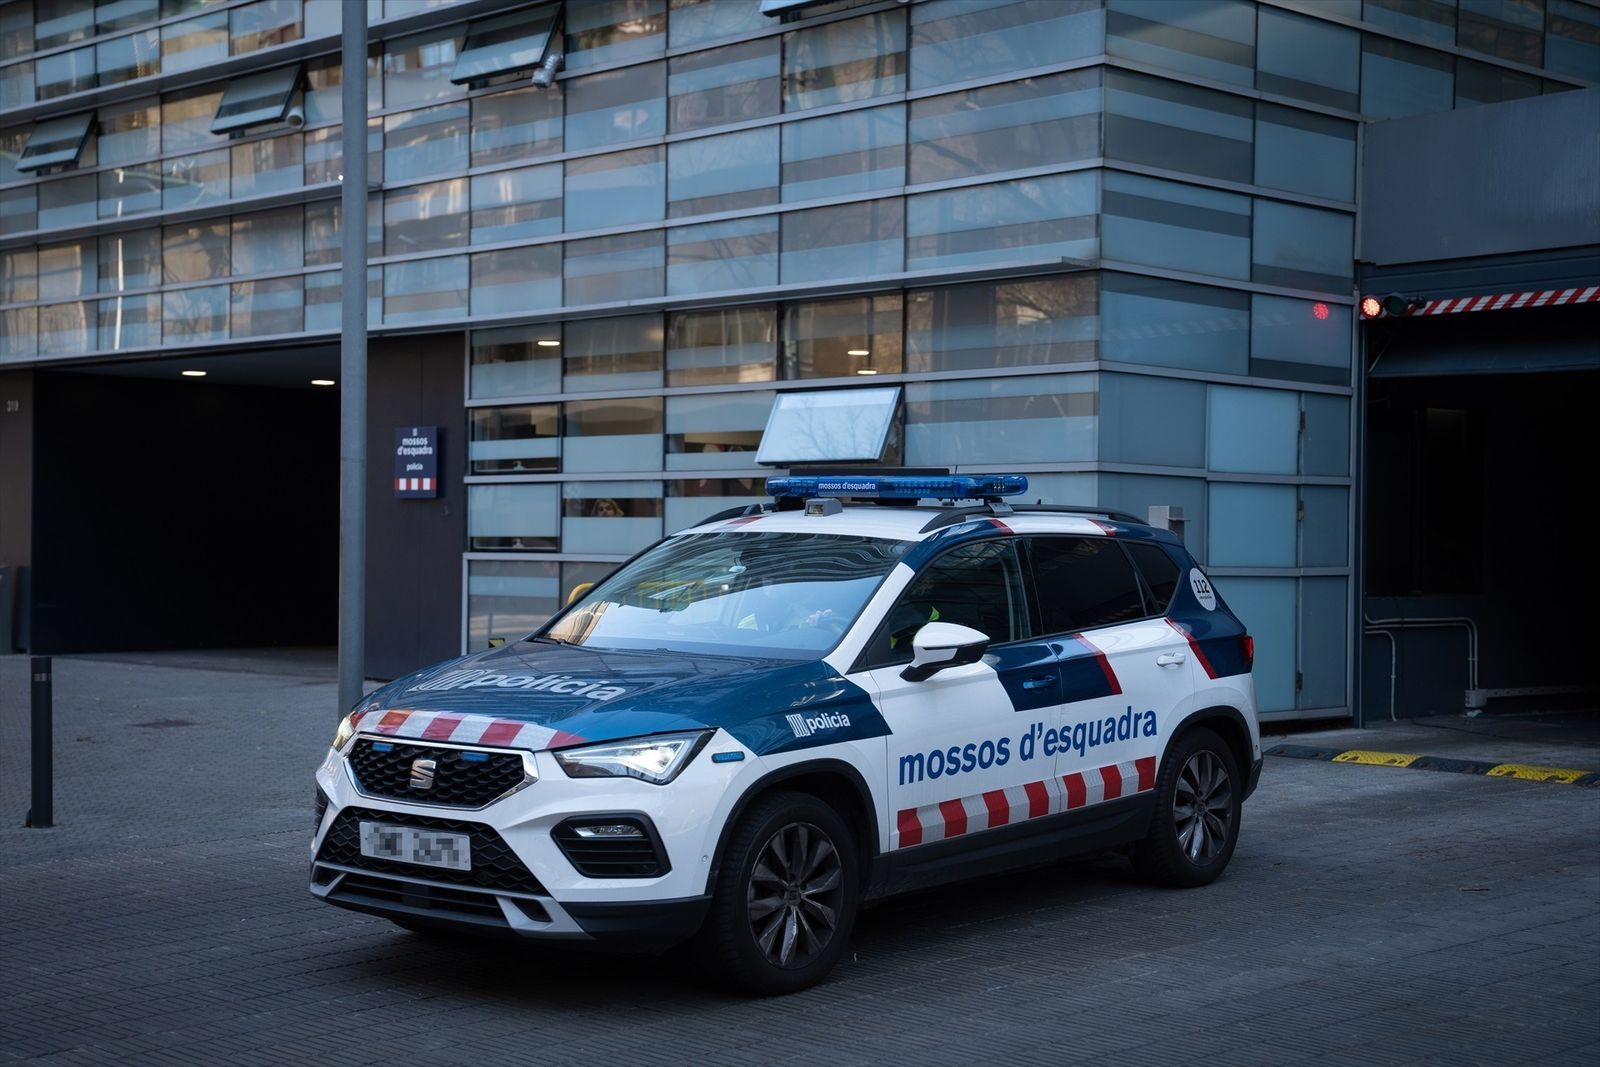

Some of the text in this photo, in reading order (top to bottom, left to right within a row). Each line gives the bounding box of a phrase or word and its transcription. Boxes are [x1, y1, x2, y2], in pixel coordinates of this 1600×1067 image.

[402, 438, 428, 446] mossos
[397, 446, 433, 457] d'esquadra
[842, 482, 876, 490] d'esquadra
[1193, 580, 1210, 593] 112
[458, 673, 627, 701] policia
[806, 711, 851, 734] policia
[899, 706, 1158, 786] mossos d'esquadra
